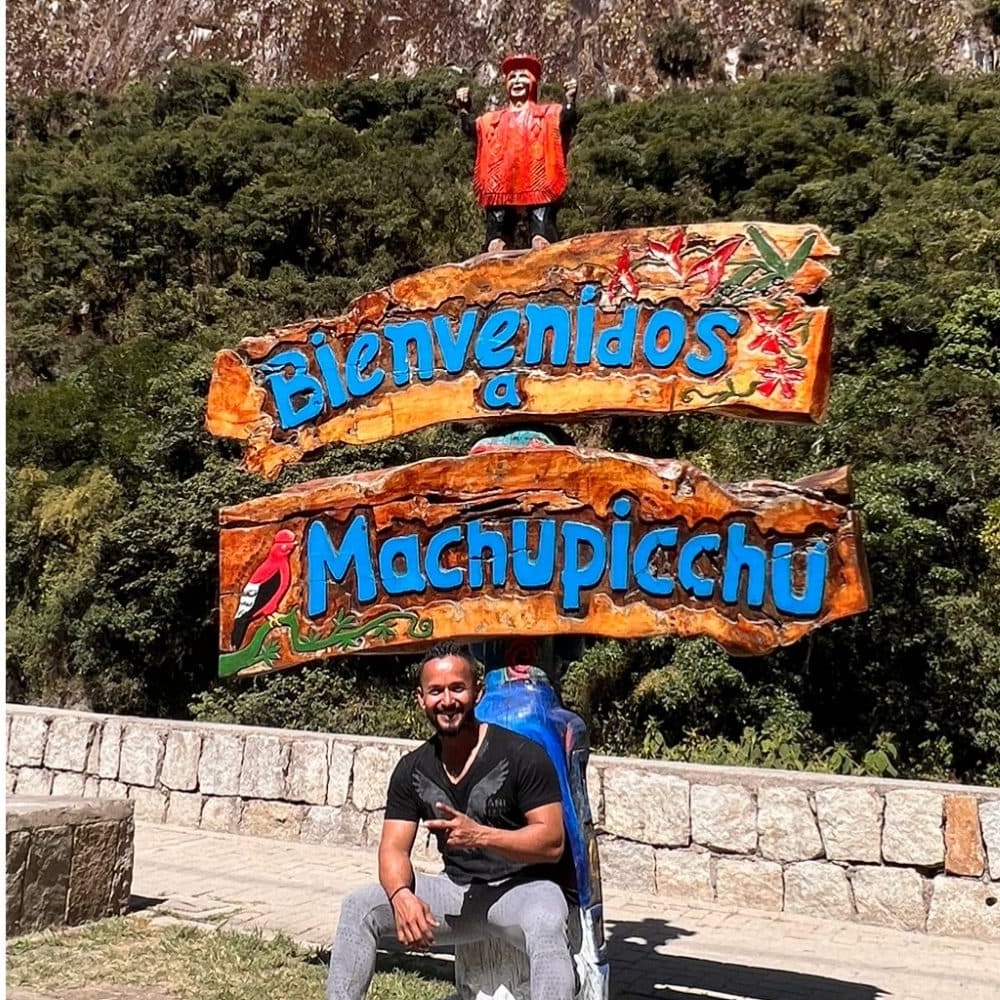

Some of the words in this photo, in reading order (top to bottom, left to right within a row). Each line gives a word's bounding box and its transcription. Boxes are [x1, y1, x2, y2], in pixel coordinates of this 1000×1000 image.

[260, 283, 743, 430] Bienvenidos
[482, 371, 522, 409] a
[305, 497, 828, 617] Machupicchu
